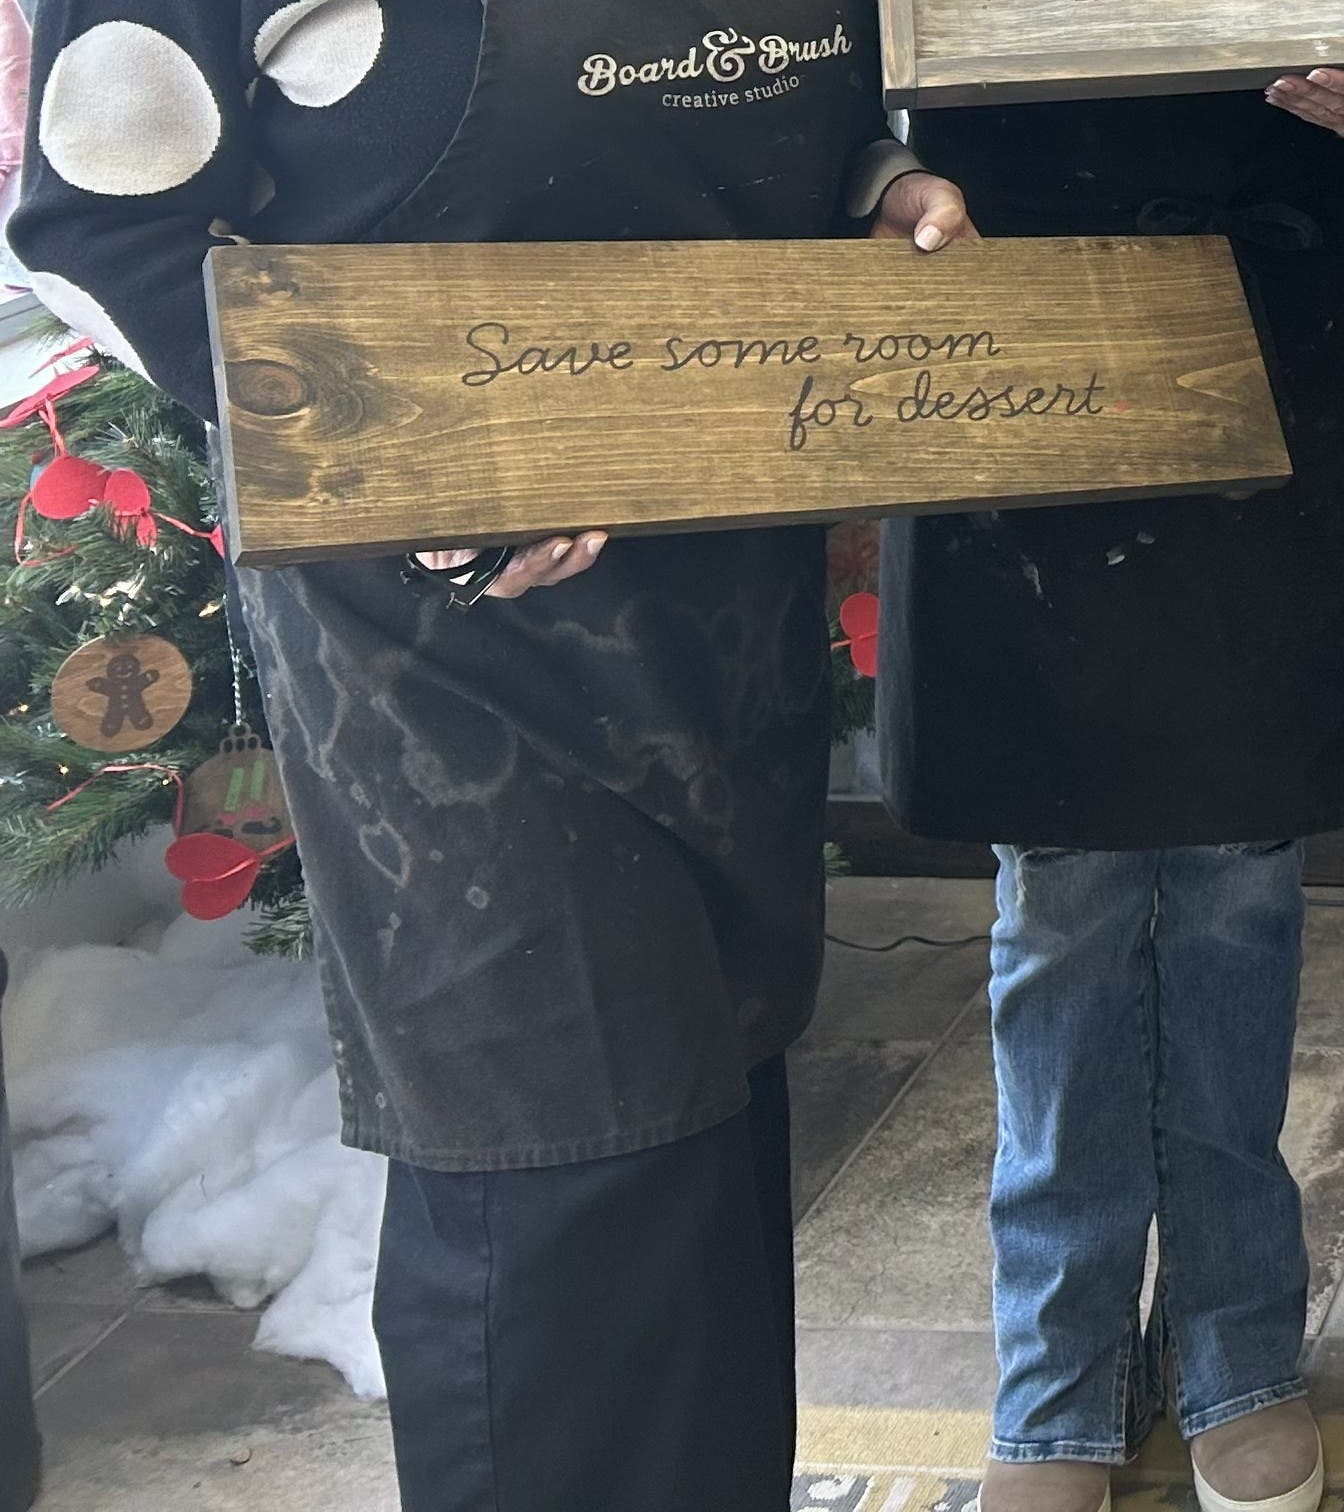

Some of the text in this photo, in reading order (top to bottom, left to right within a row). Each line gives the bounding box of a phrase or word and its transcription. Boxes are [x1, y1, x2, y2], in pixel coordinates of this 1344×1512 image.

[577, 23, 853, 97] Board & Brush
[662, 74, 800, 109] creative studio
[460, 320, 1001, 389] Save some room
[787, 369, 1107, 452] for dessert
